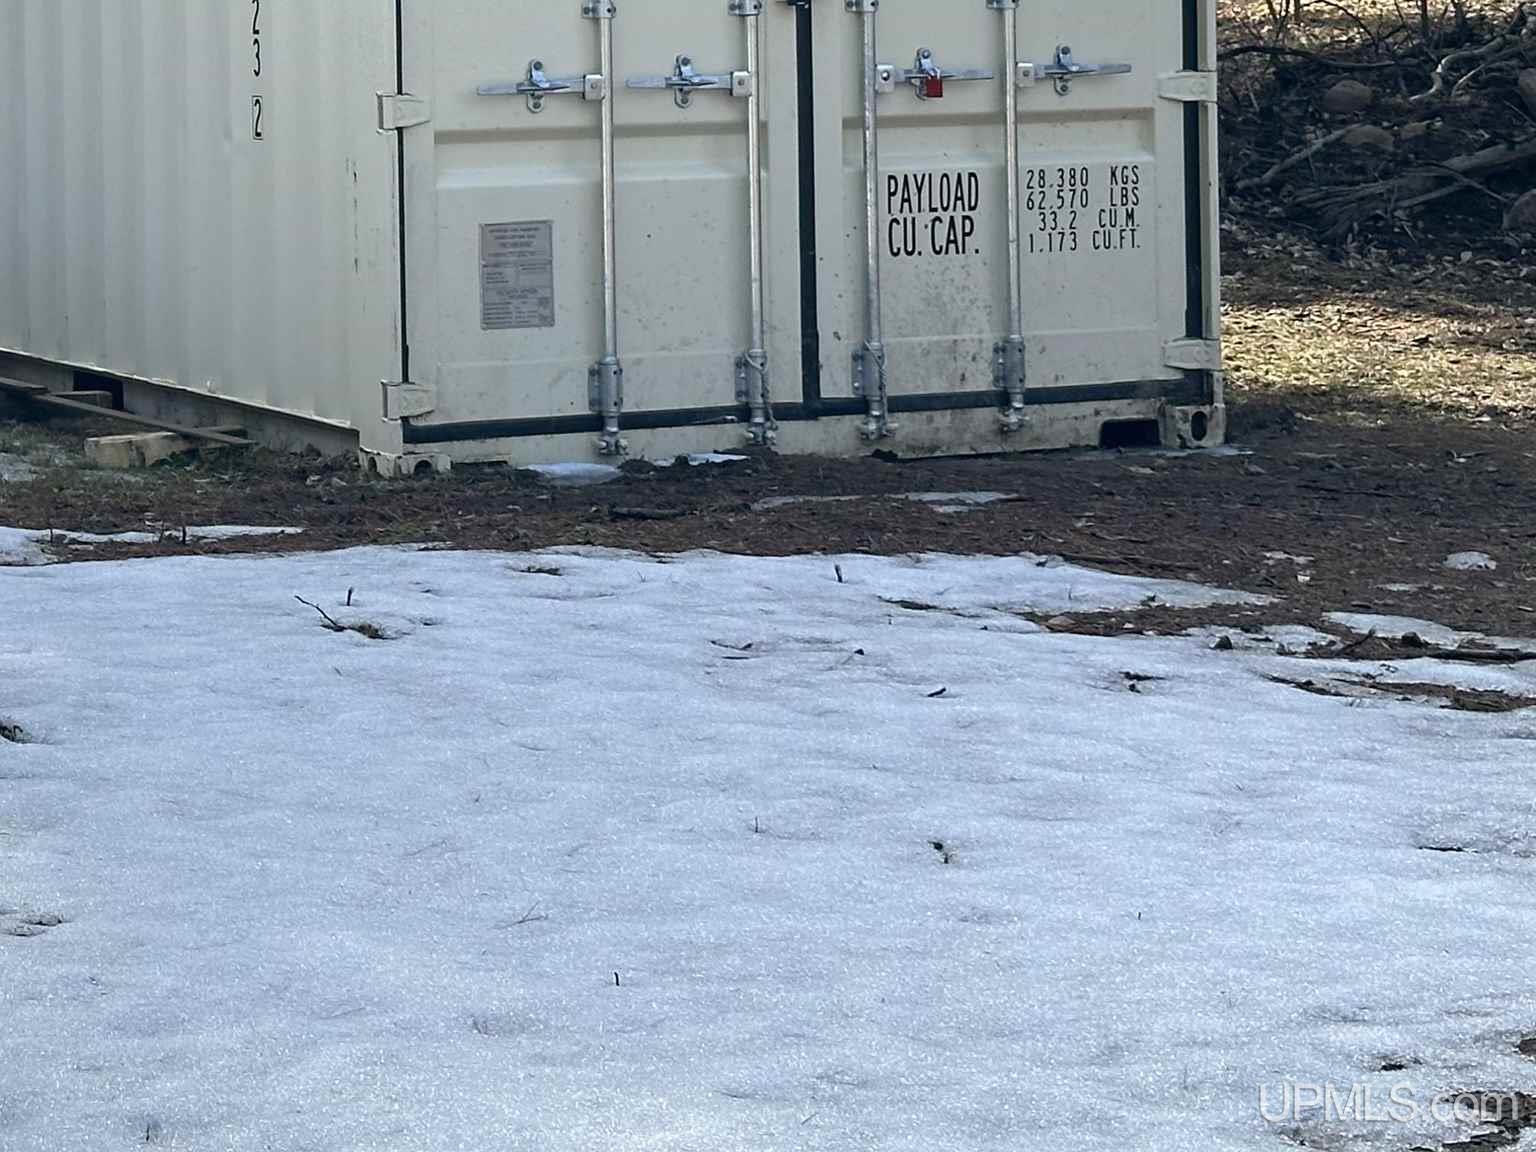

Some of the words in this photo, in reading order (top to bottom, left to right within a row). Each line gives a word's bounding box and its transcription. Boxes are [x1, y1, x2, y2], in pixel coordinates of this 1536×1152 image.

[253, 99, 263, 138] 2
[1026, 166, 1089, 190] 28.380
[1109, 165, 1140, 187] KGS
[887, 171, 980, 215] PAYLOAD
[1026, 188, 1089, 211] 62.570
[1109, 186, 1140, 208] LBS
[1038, 210, 1077, 232] 33.2
[1098, 206, 1141, 229] CU.M.
[888, 217, 923, 257] CU.
[930, 214, 980, 256] CAP.
[1029, 231, 1078, 254] 1.173
[1092, 228, 1141, 251] CU.FT.
